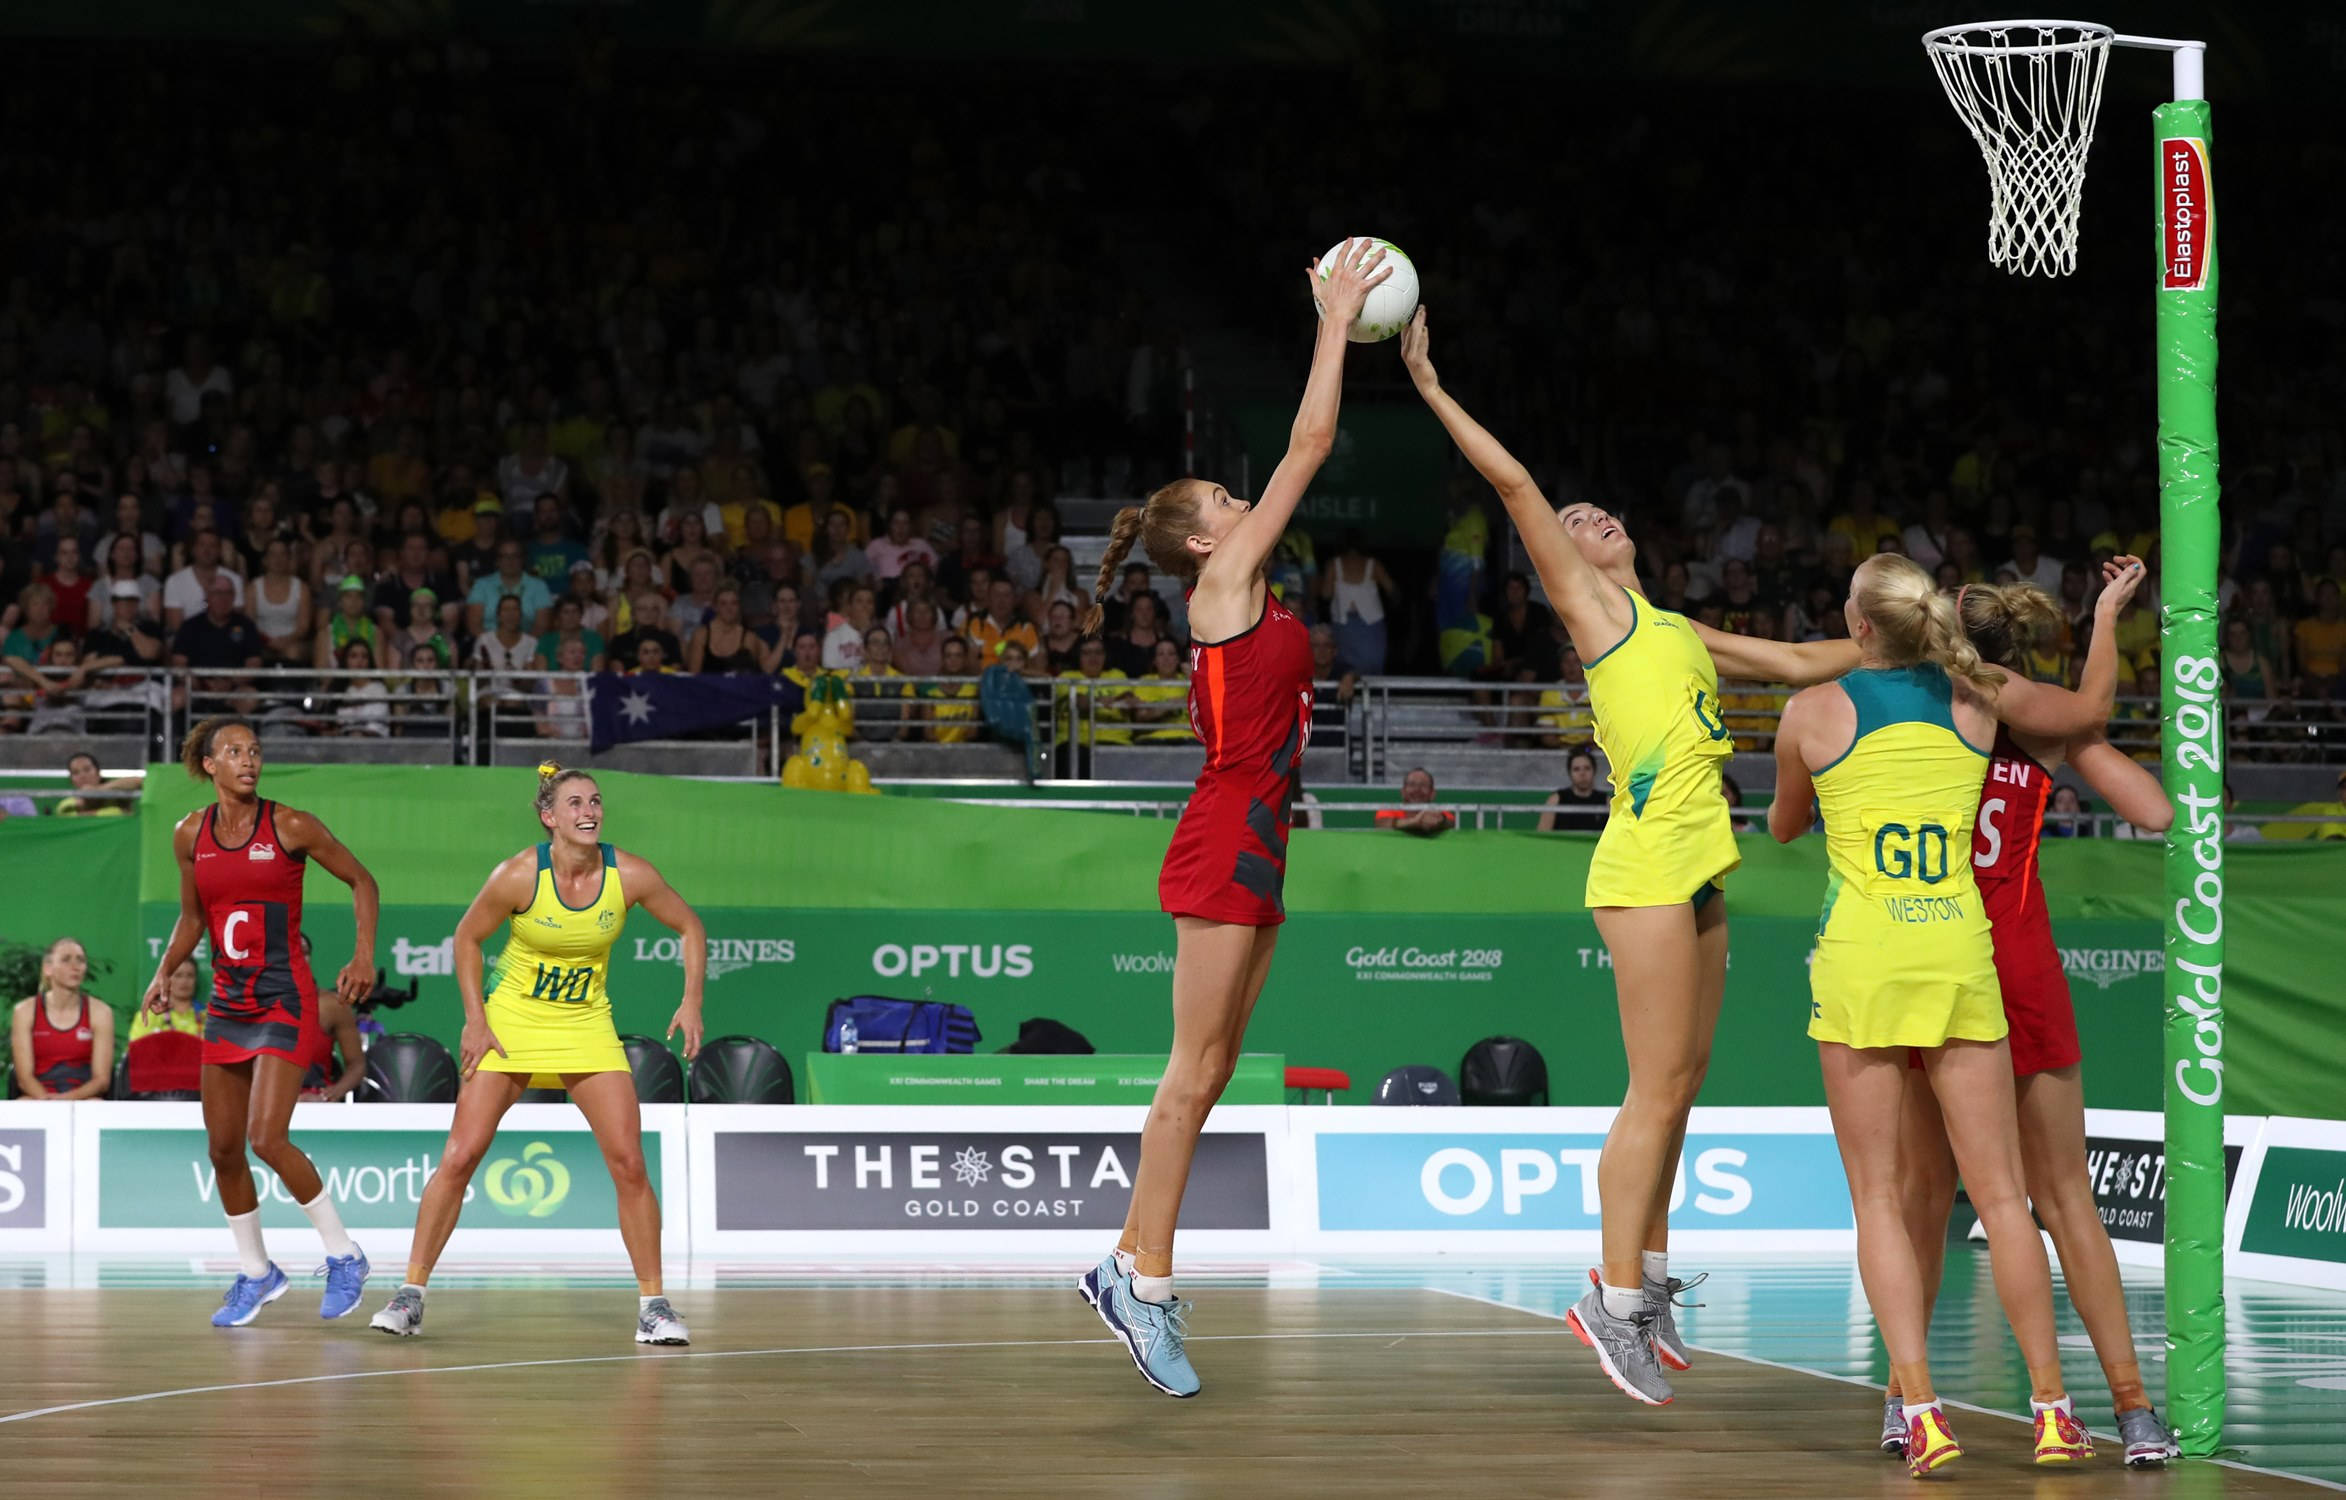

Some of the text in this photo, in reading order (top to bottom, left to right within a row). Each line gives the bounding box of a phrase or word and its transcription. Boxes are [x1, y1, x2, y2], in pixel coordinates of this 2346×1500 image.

[2172, 151, 2194, 278] Elastoplast
[1992, 758, 2030, 788] EN
[1974, 798, 2007, 868] S
[1875, 823, 1948, 884] GD
[2174, 655, 2223, 1106] Gold Coast 2018
[1885, 896, 1964, 923] WESTON
[223, 910, 249, 960] C
[391, 937, 485, 975] taf
[872, 944, 1033, 978] OPTUS
[1112, 950, 1176, 973] Woolw
[1345, 946, 1503, 968] Gold Coast 2018
[1577, 948, 1612, 968] TH
[532, 962, 595, 1002] WD
[1459, 972, 1492, 981] GAMES
[1050, 1078, 1066, 1086] THE
[804, 1145, 1131, 1189] THE STA
[1420, 1147, 1753, 1216] OPTS
[2088, 1150, 2120, 1195] HE
[905, 1199, 1084, 1217] GOLD COAST
[2097, 1206, 2154, 1230] OLD COAST
